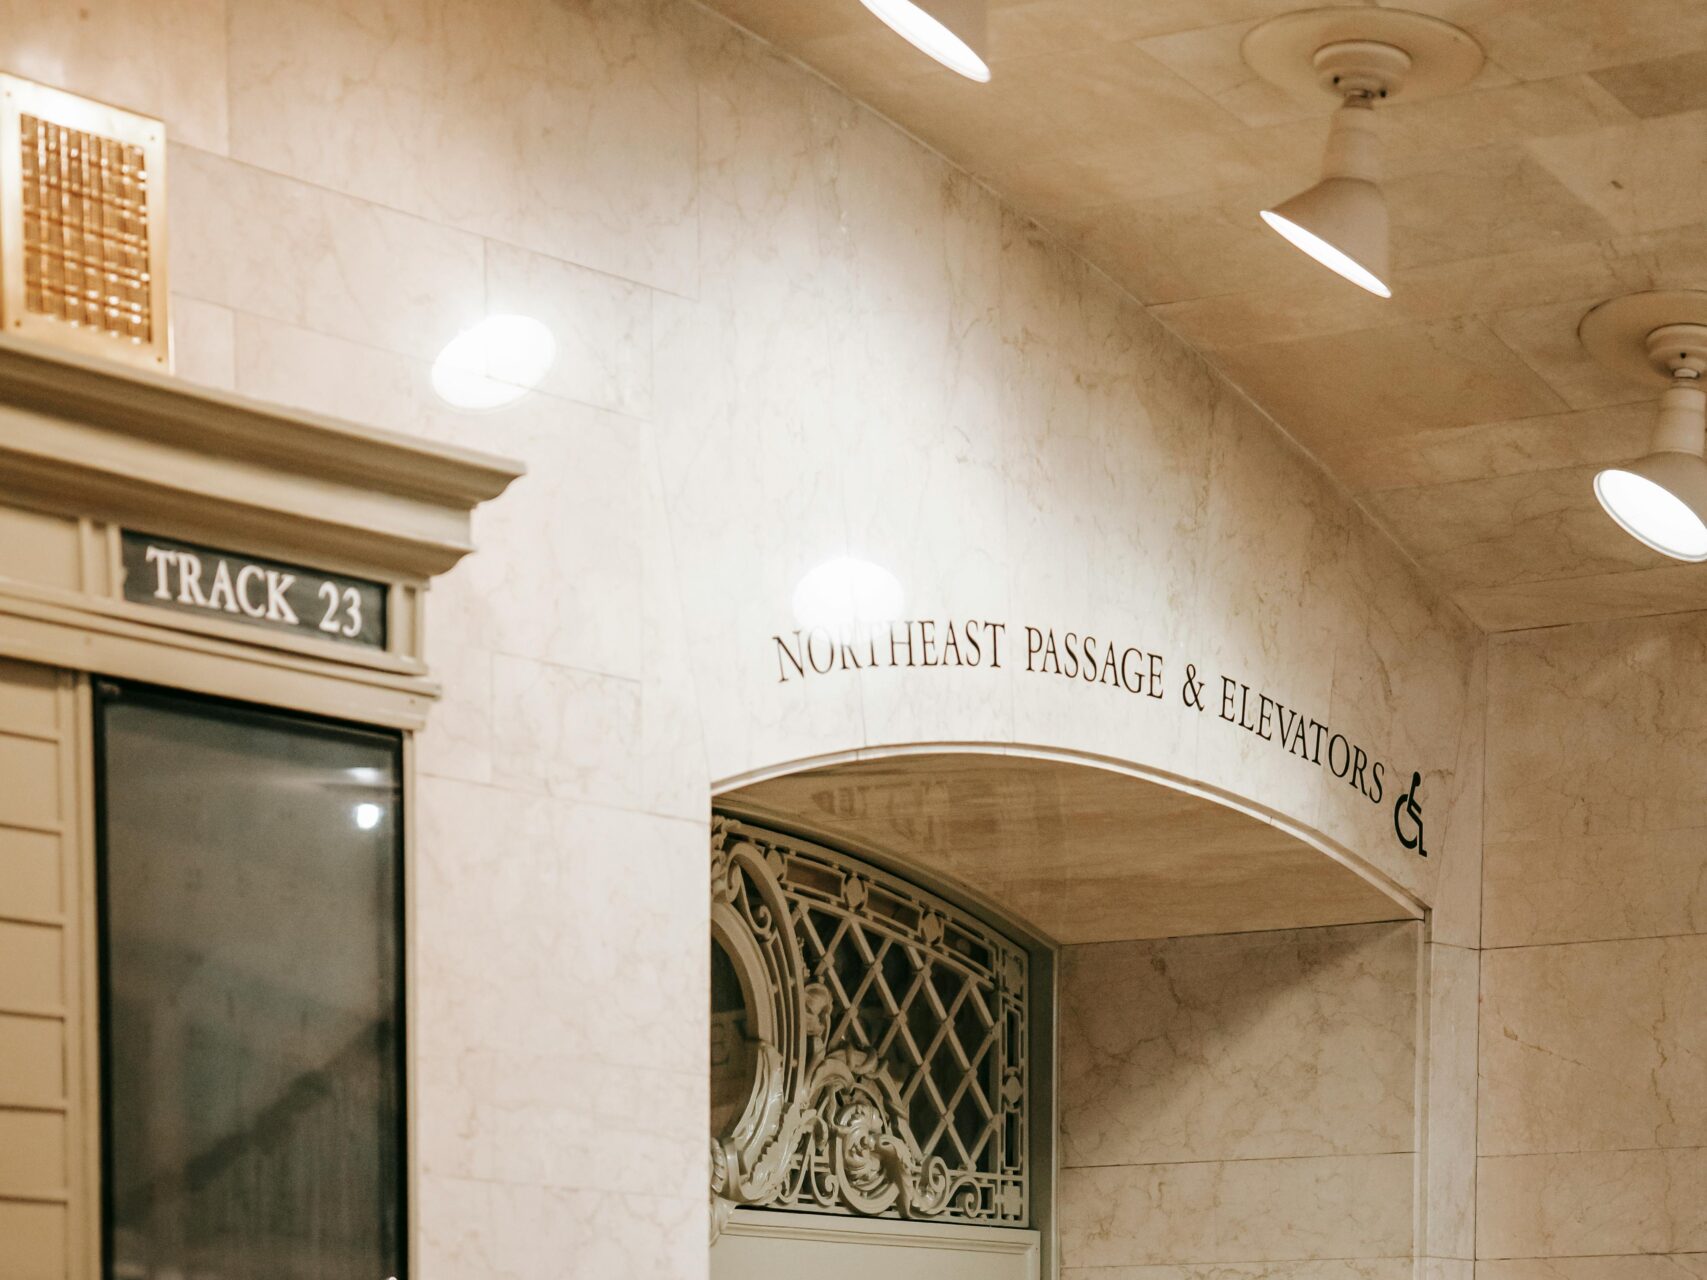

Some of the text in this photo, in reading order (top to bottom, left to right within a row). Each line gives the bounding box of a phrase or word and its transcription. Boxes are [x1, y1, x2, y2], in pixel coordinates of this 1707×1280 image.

[145, 545, 363, 638] TRACK 23
[772, 618, 1386, 805] NORTHEAST PASSAGE & ELEVATORS
